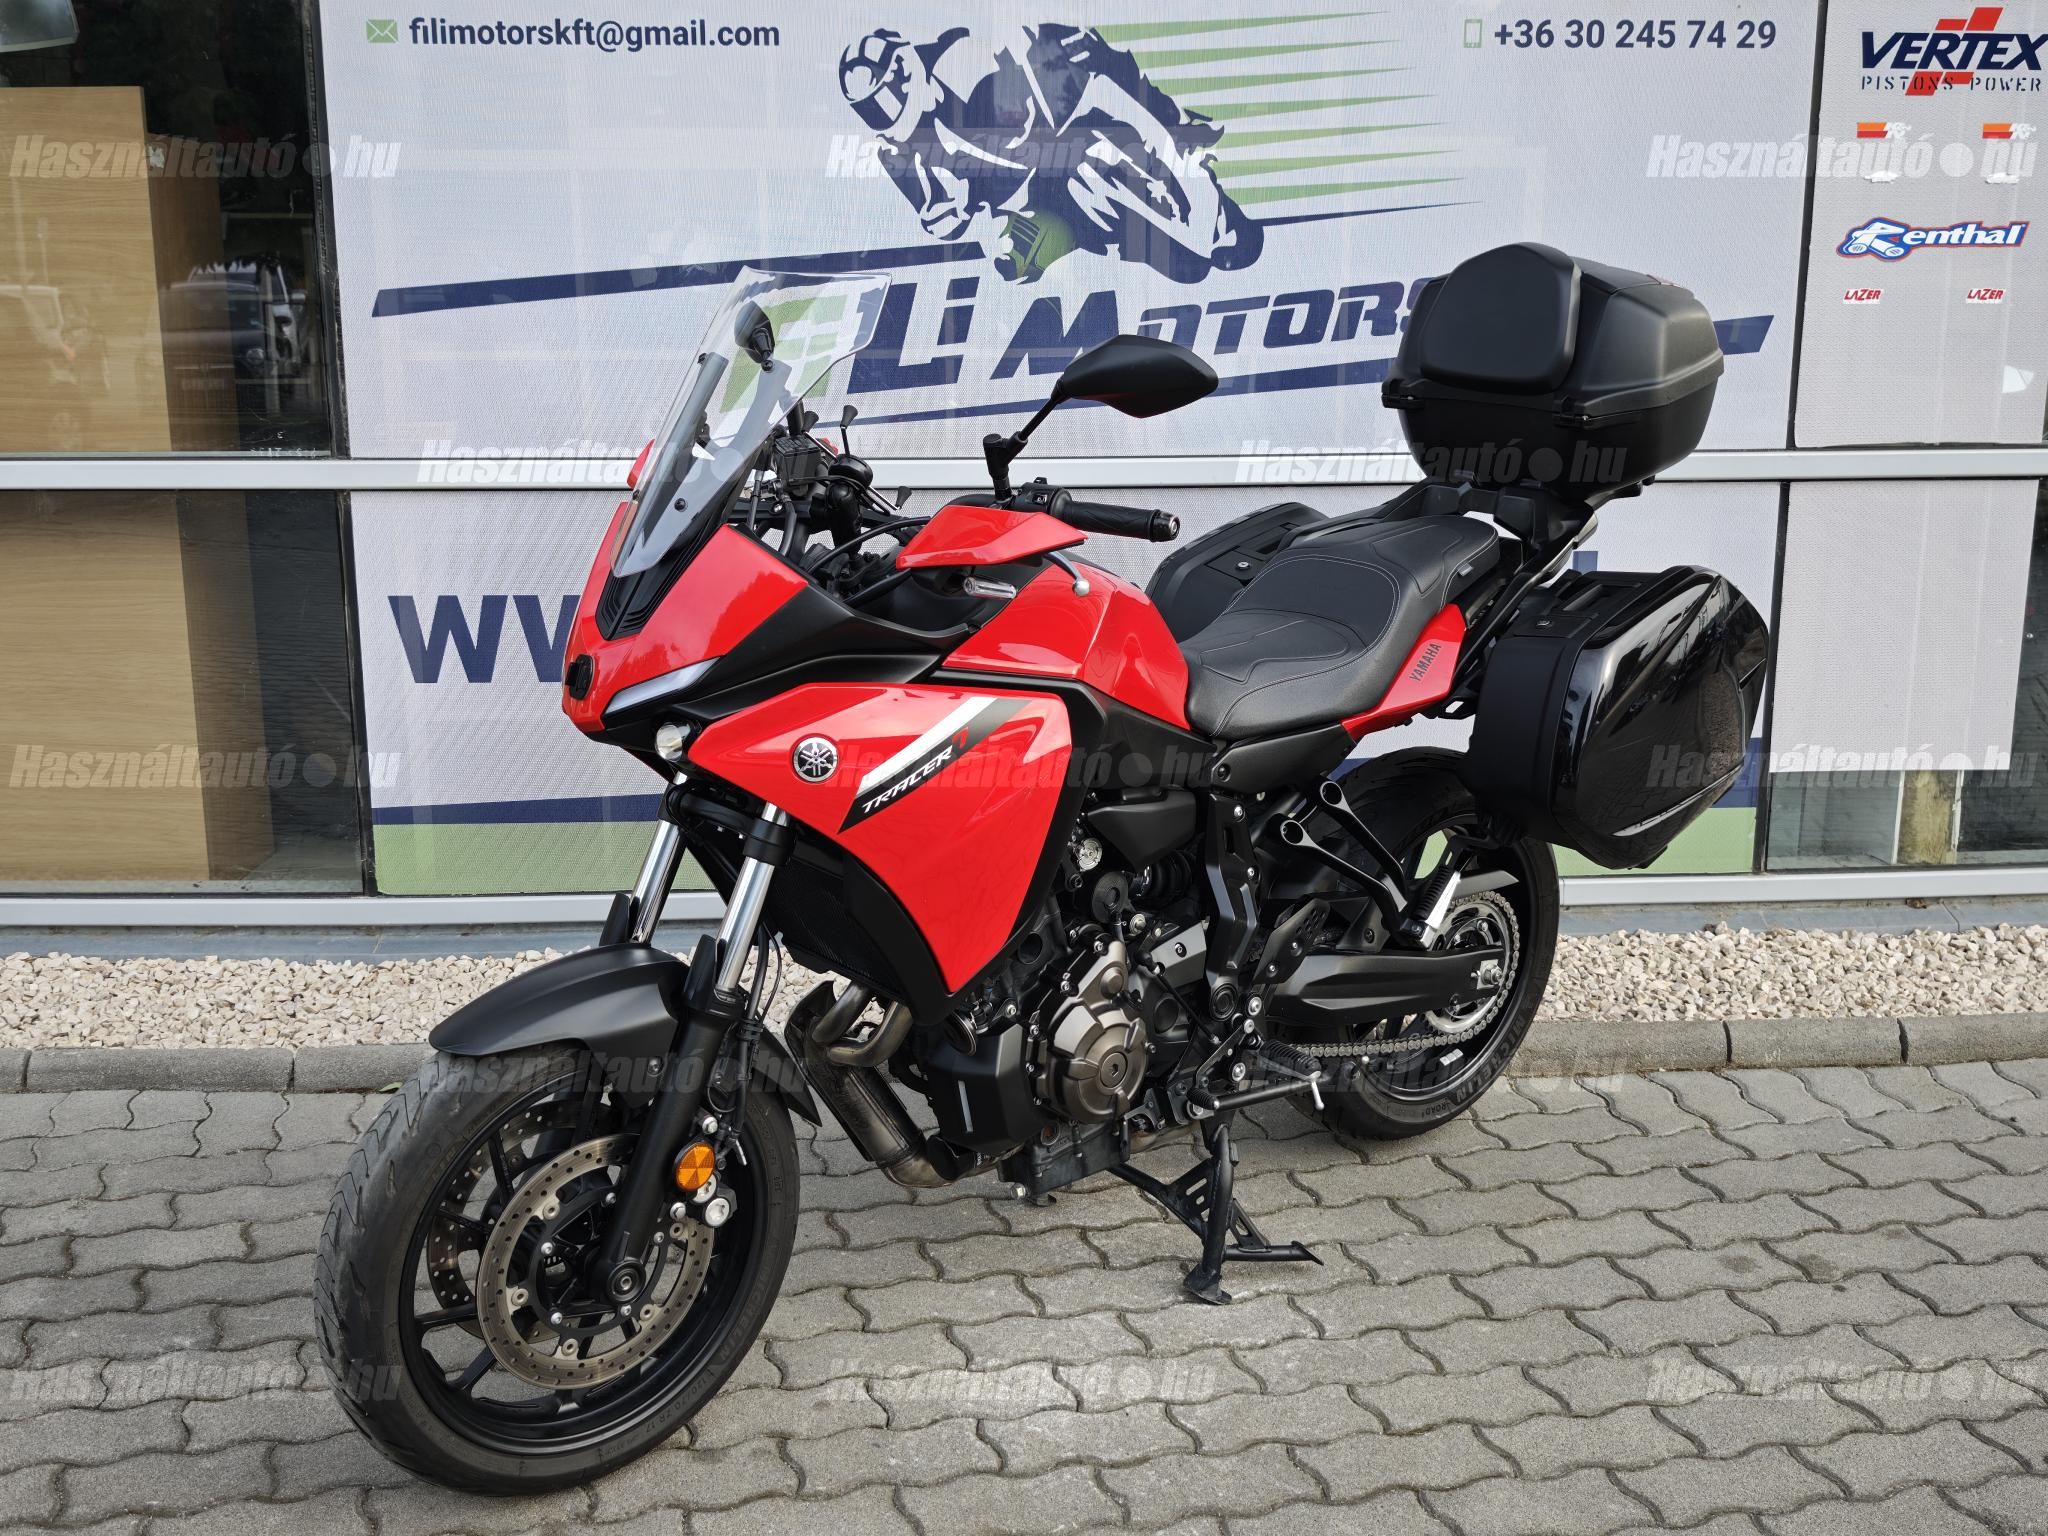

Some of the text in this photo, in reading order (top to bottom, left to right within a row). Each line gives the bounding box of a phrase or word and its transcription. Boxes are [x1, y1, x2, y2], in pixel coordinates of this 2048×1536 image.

[408, 17, 781, 52] filimotorskft@gmail.com
[1494, 19, 1777, 48] +36 30 245 74 29
[1862, 31, 2048, 71] VERTEX
[1861, 75, 2041, 92] PISTONS POWER
[1844, 288, 1882, 300] LAZER
[1967, 288, 2004, 300] LAZER
[1409, 643, 1442, 681] YAMAHA
[862, 727, 969, 813] TRACER 7
